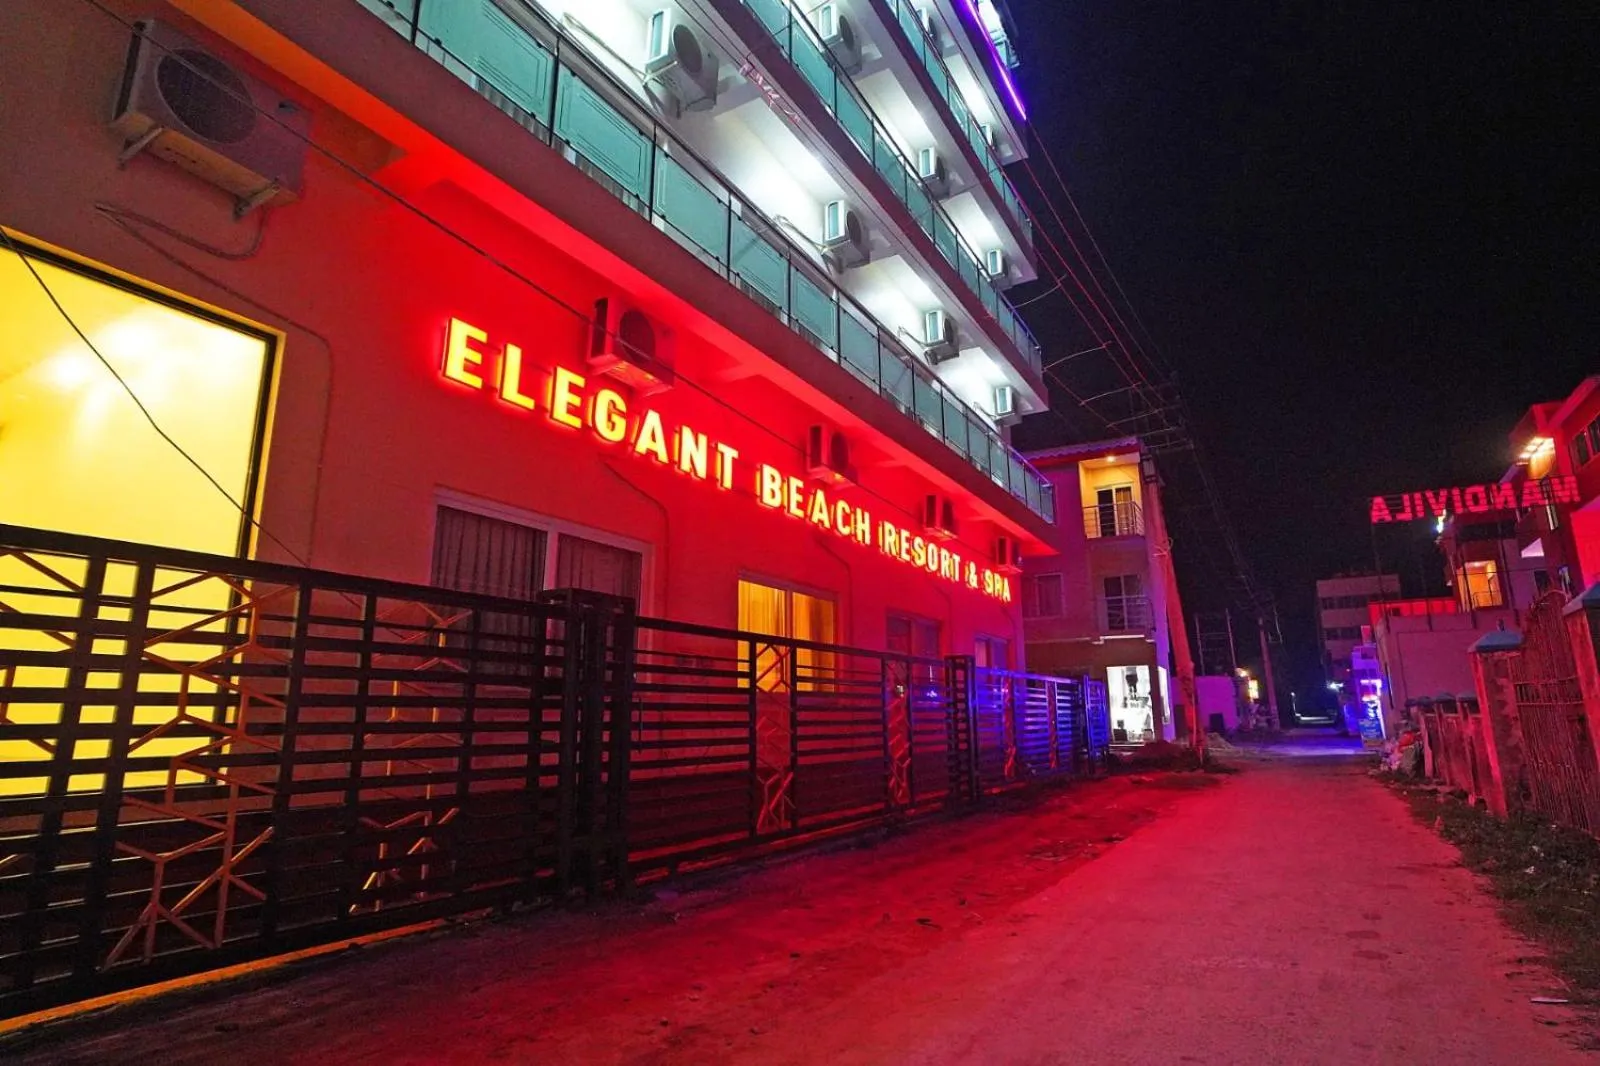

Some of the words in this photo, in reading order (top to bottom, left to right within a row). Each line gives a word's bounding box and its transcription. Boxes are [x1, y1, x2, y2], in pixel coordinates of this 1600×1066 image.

[444, 316, 739, 490] ELEGANT
[759, 463, 871, 545] BEACH
[880, 520, 961, 582] RESORT
[967, 560, 979, 588] &
[983, 568, 1012, 602] SPA
